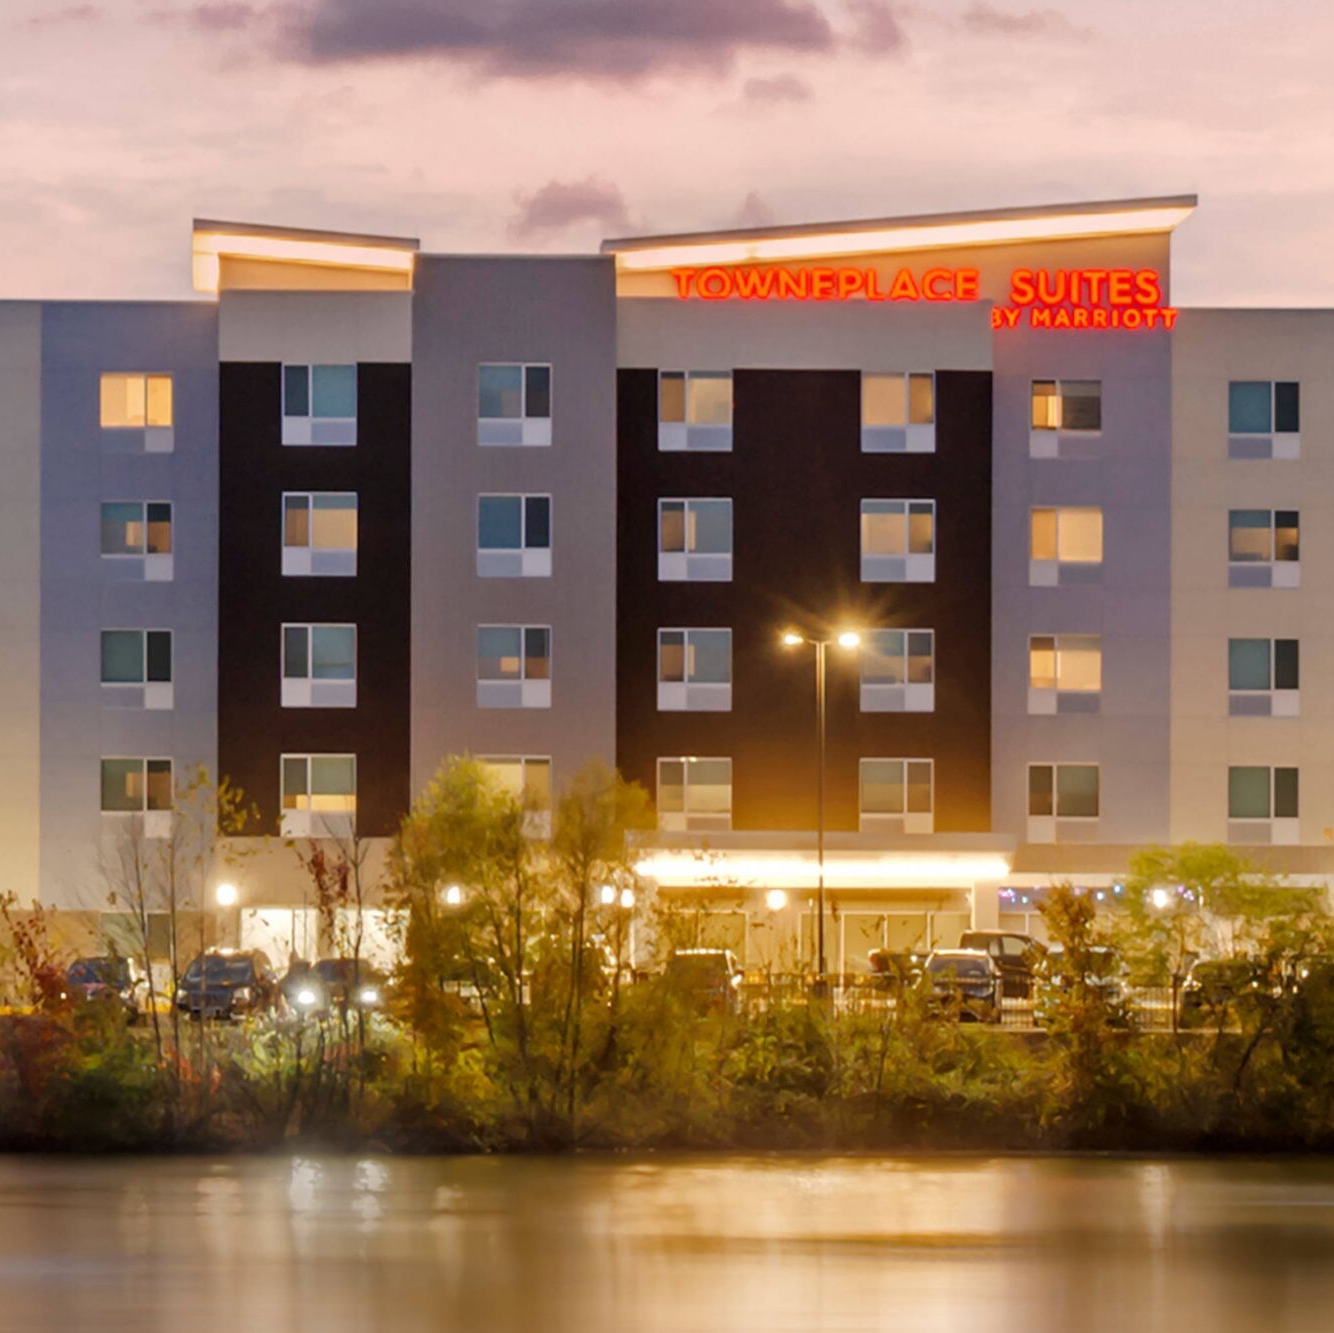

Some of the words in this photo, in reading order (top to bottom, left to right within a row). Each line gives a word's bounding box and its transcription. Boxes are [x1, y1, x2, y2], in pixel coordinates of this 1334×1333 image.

[671, 266, 980, 301] TOWNEPLACE
[1010, 268, 1161, 306] SUITES
[991, 306, 1020, 329] BY
[1030, 306, 1178, 330] MARRIOTT
